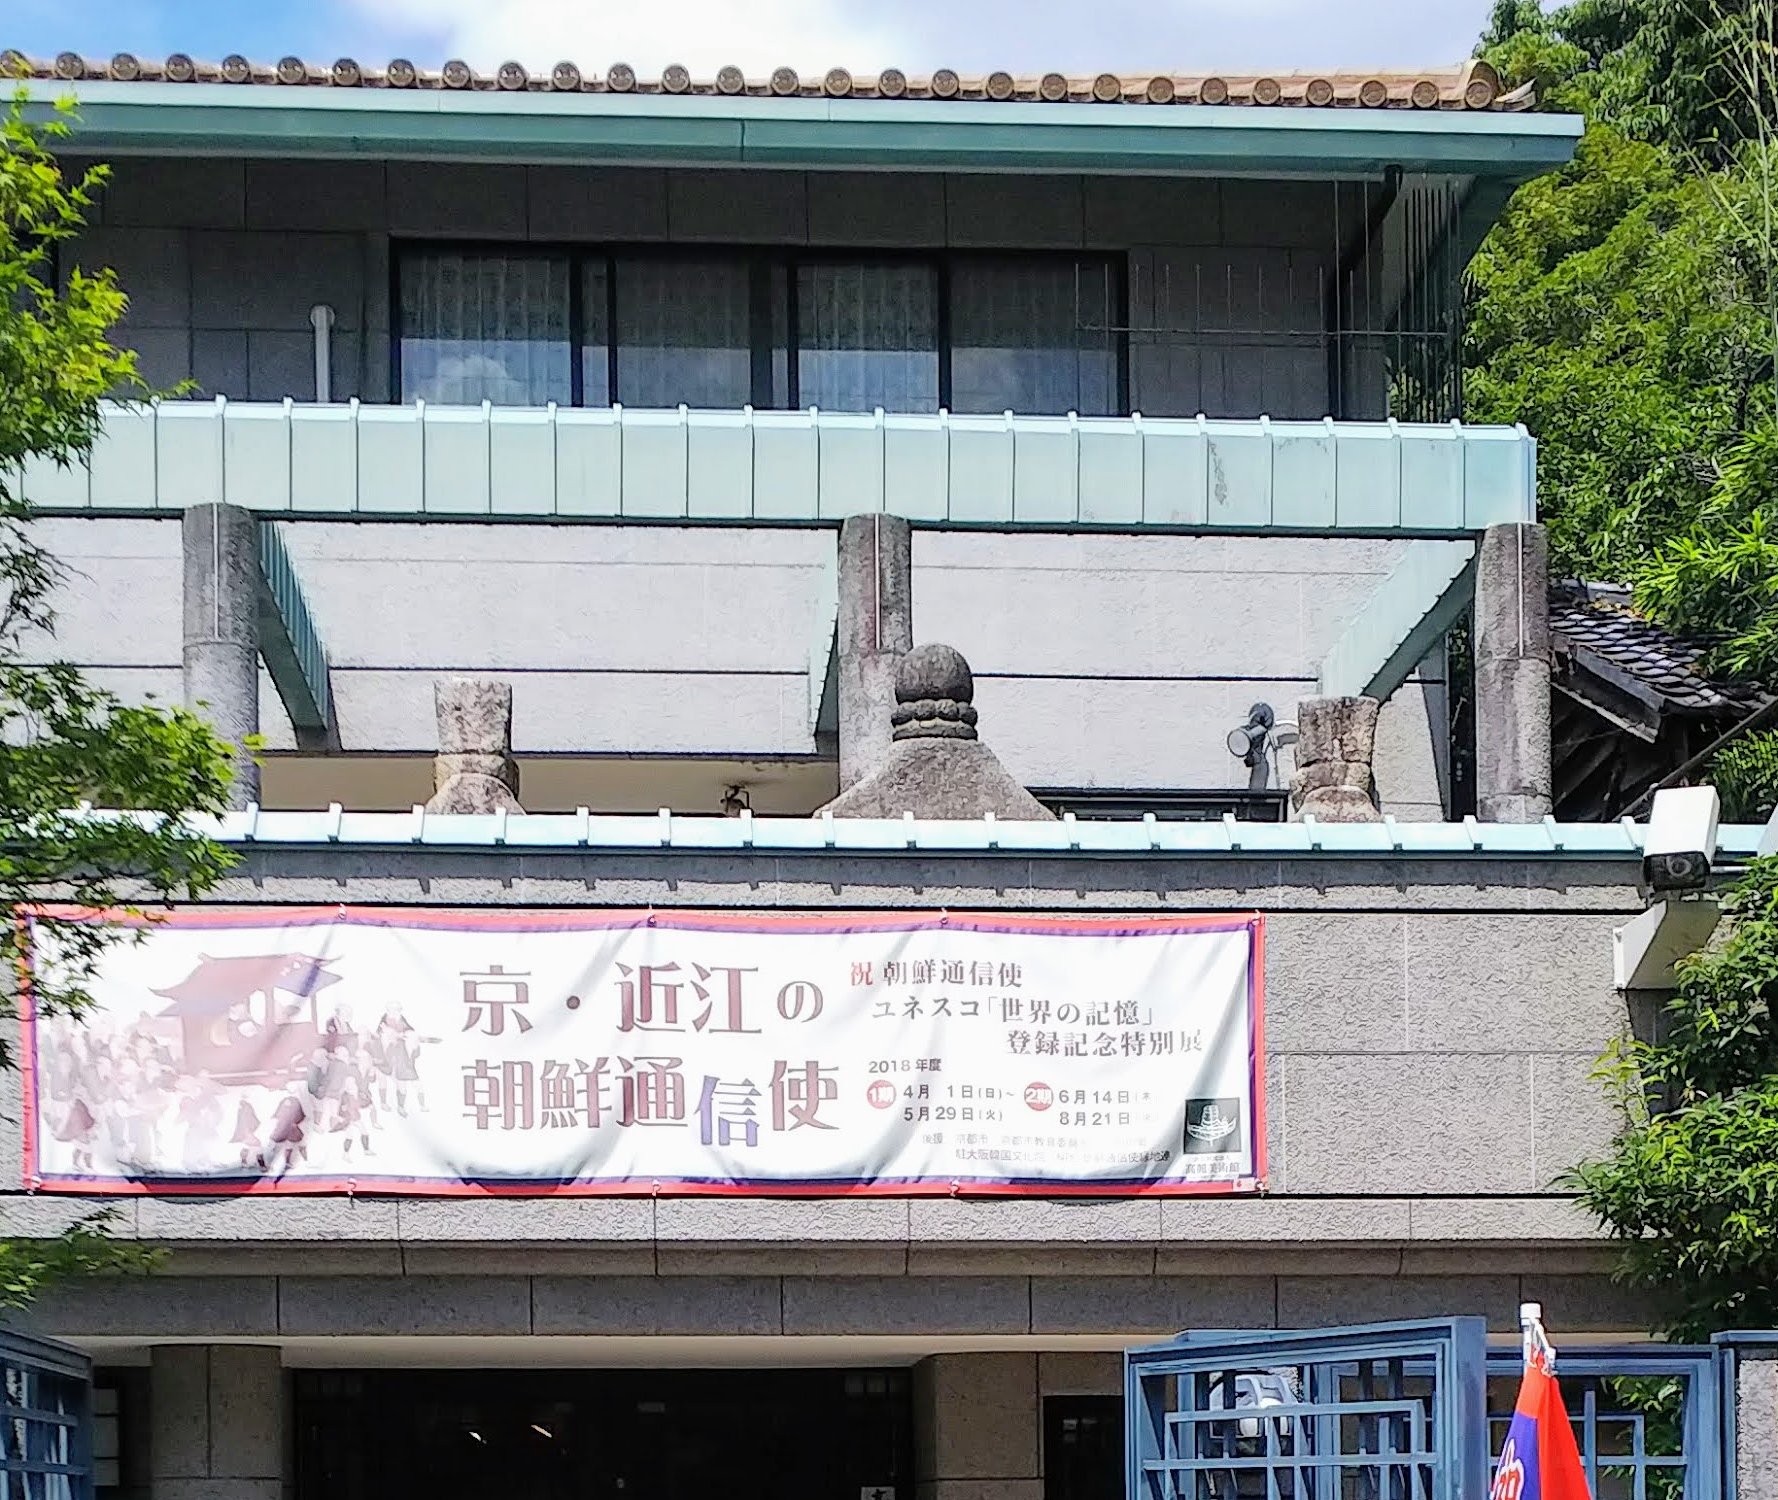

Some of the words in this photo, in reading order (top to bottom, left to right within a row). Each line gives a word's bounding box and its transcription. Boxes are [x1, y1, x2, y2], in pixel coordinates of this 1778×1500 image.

[850, 961, 874, 987] 祝
[882, 959, 1023, 988] 朝鮮通信使
[459, 961, 824, 1036] 京・近江の
[871, 996, 1154, 1026] ユネスコ「世界の記憶」
[1006, 1030, 1203, 1057] 登録記念特別展
[461, 1056, 841, 1147] 朝鮮通信使
